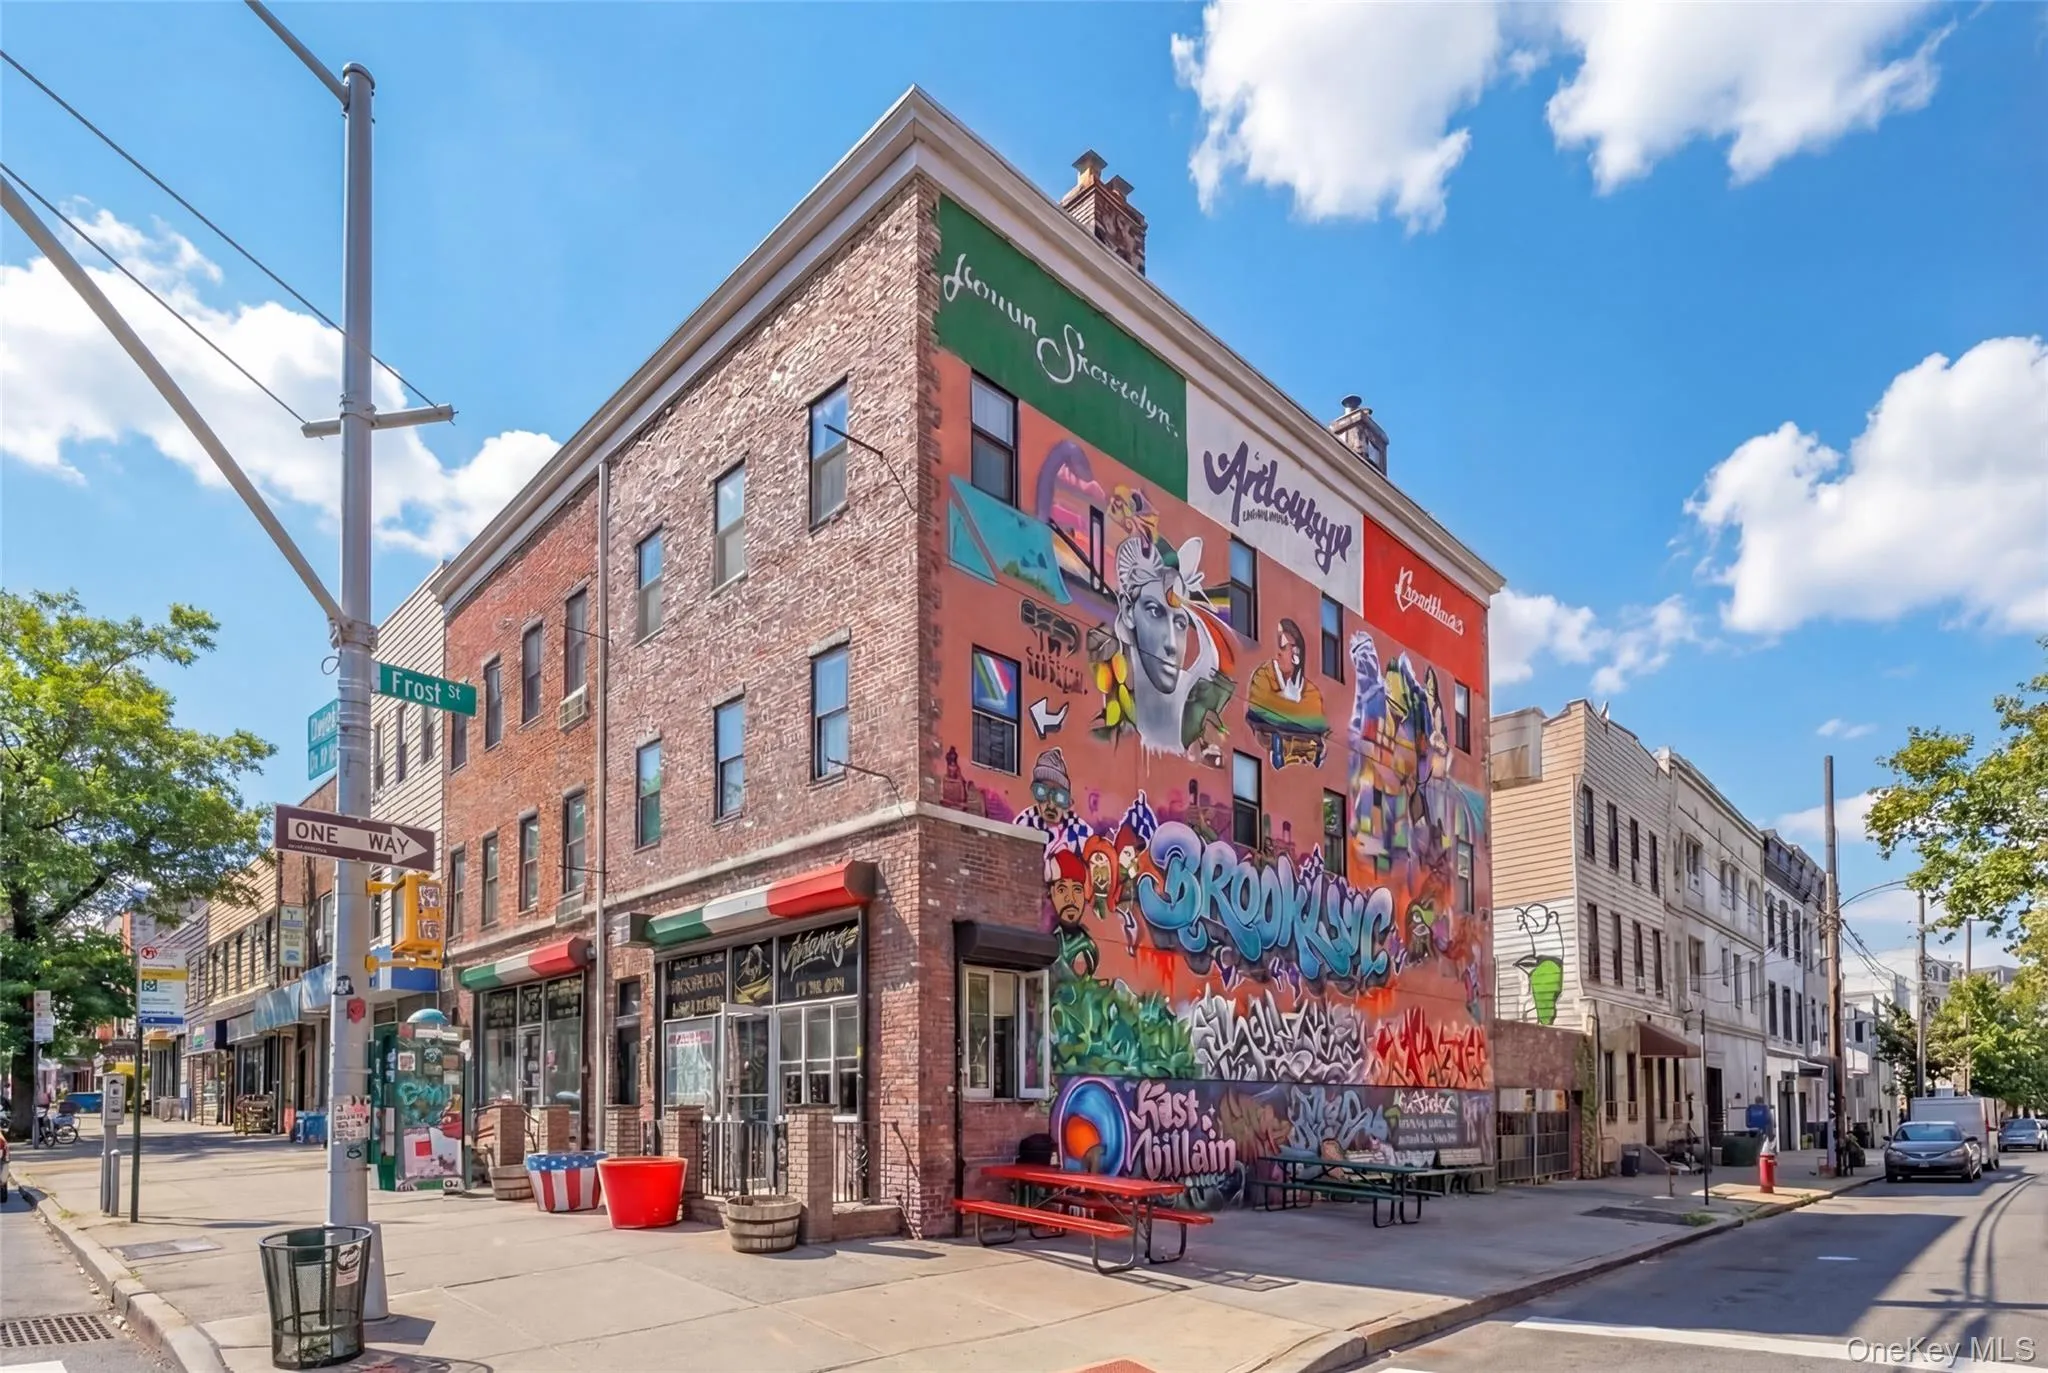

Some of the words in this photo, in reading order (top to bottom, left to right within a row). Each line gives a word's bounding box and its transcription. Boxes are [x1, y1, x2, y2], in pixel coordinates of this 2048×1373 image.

[391, 670, 441, 704] Frost
[448, 684, 461, 701] St
[295, 821, 339, 845] ONE
[368, 833, 410, 856] WAY
